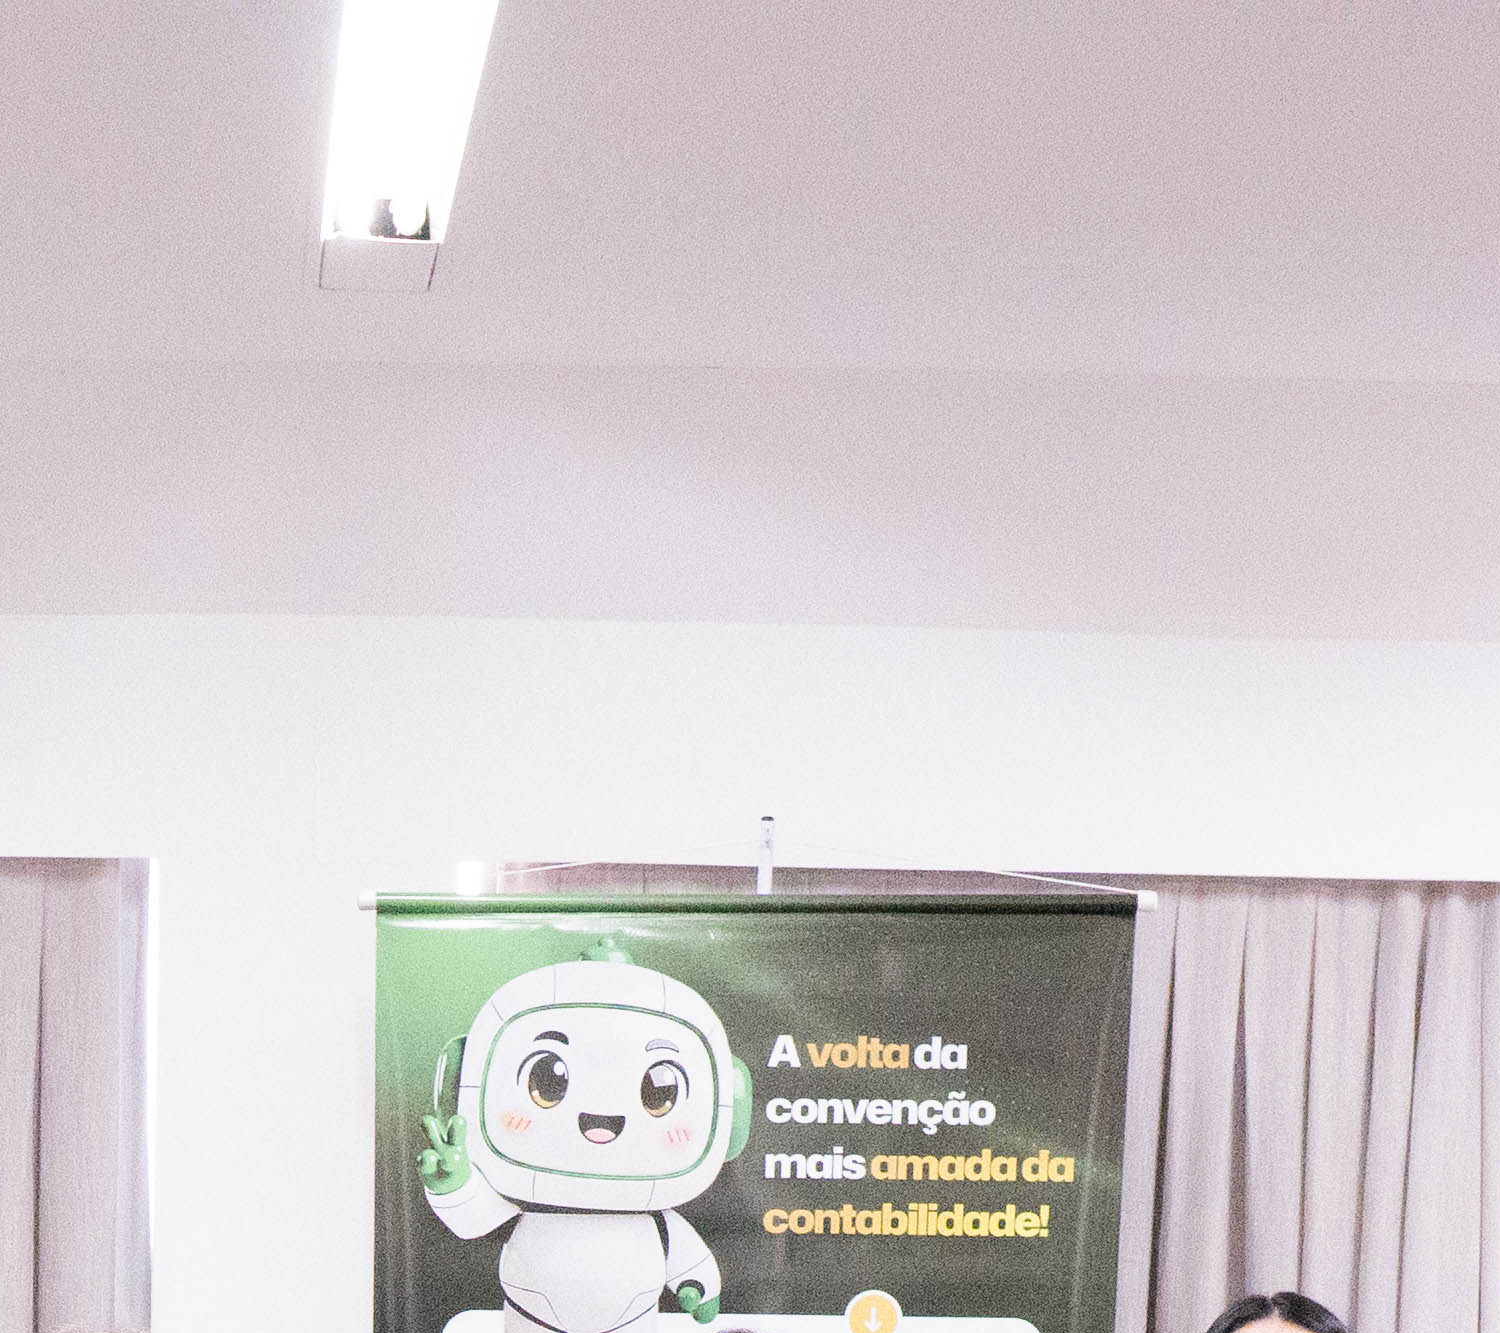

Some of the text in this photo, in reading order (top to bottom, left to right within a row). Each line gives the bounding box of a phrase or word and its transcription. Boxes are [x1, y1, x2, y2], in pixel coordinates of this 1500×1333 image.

[767, 1034, 968, 1070] A volta da
[766, 1091, 996, 1136] convenção
[764, 1146, 1075, 1183] mais amada da
[763, 1203, 1050, 1238] contabilidade!
